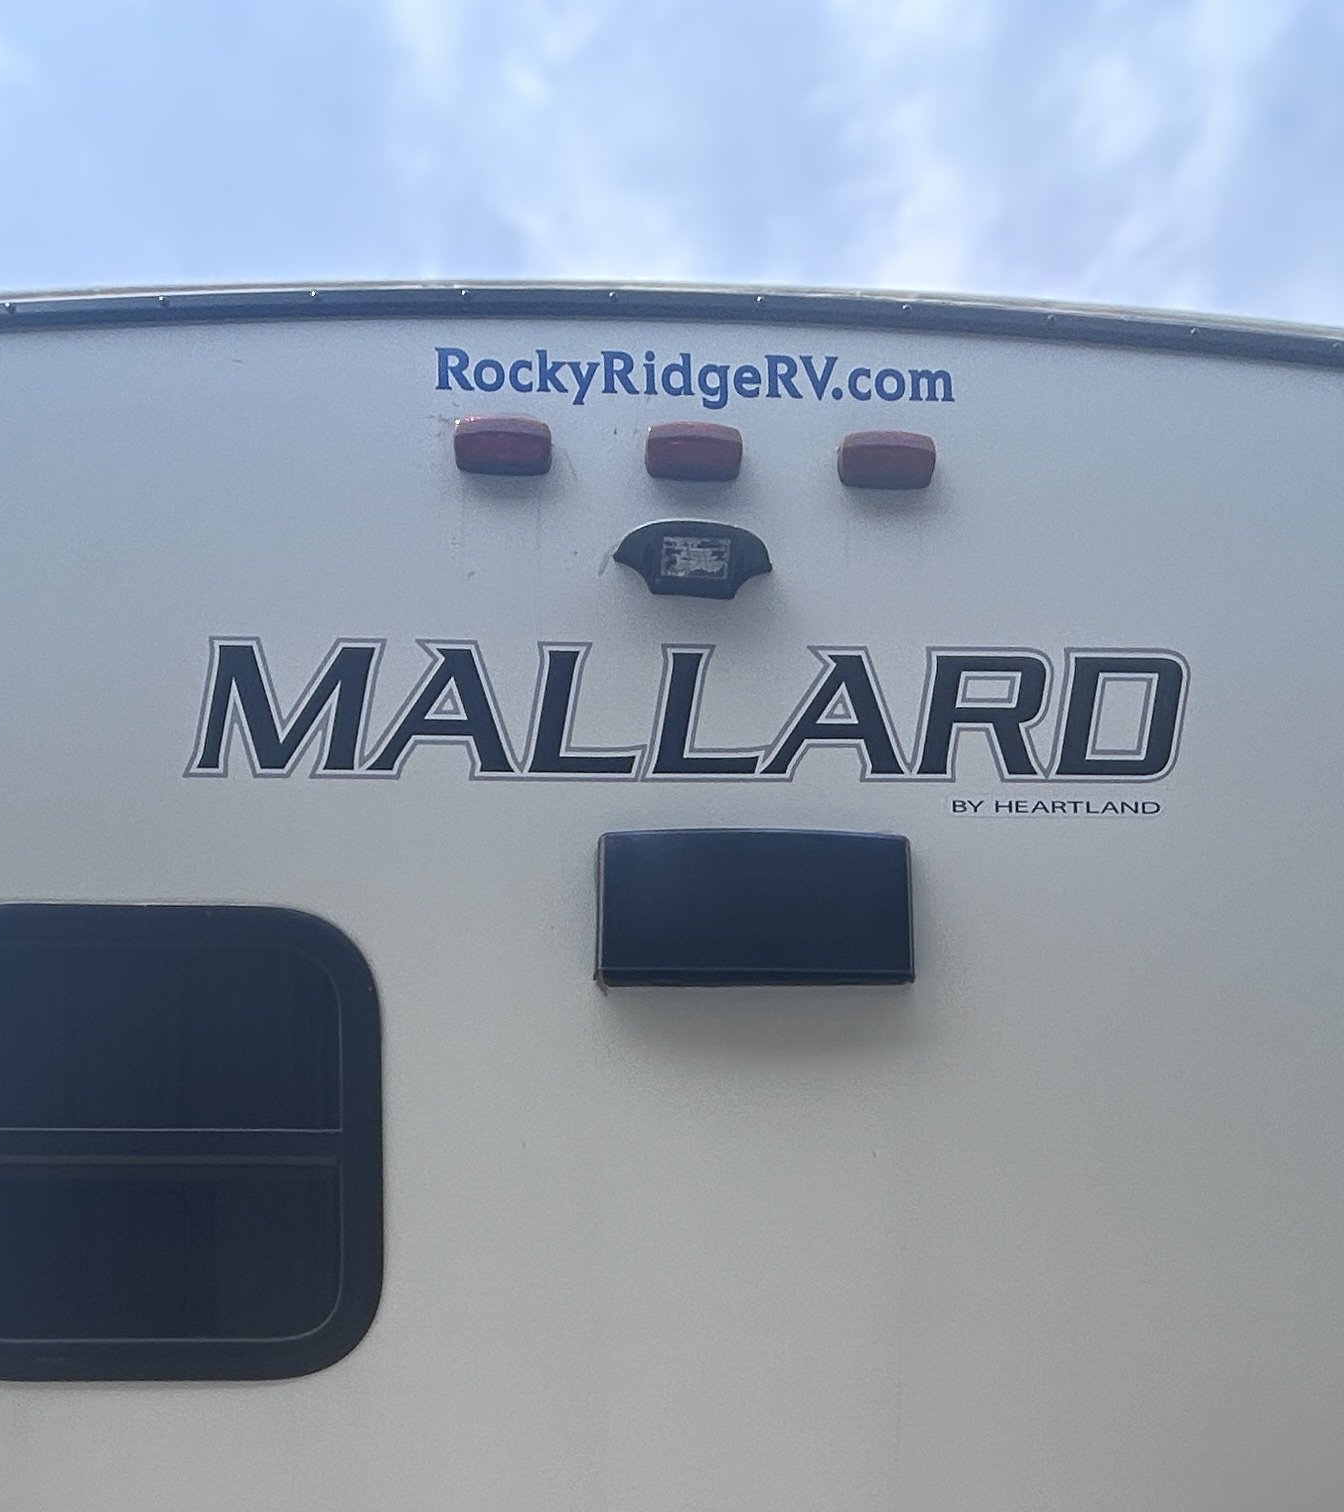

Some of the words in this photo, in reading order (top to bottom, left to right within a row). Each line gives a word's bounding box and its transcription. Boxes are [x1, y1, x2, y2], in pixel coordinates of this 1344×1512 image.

[434, 347, 955, 409] RockyRidgeRV.com
[183, 635, 1191, 782] MALLARD
[952, 800, 984, 813] BY
[995, 800, 1161, 815] HEARTLAND
